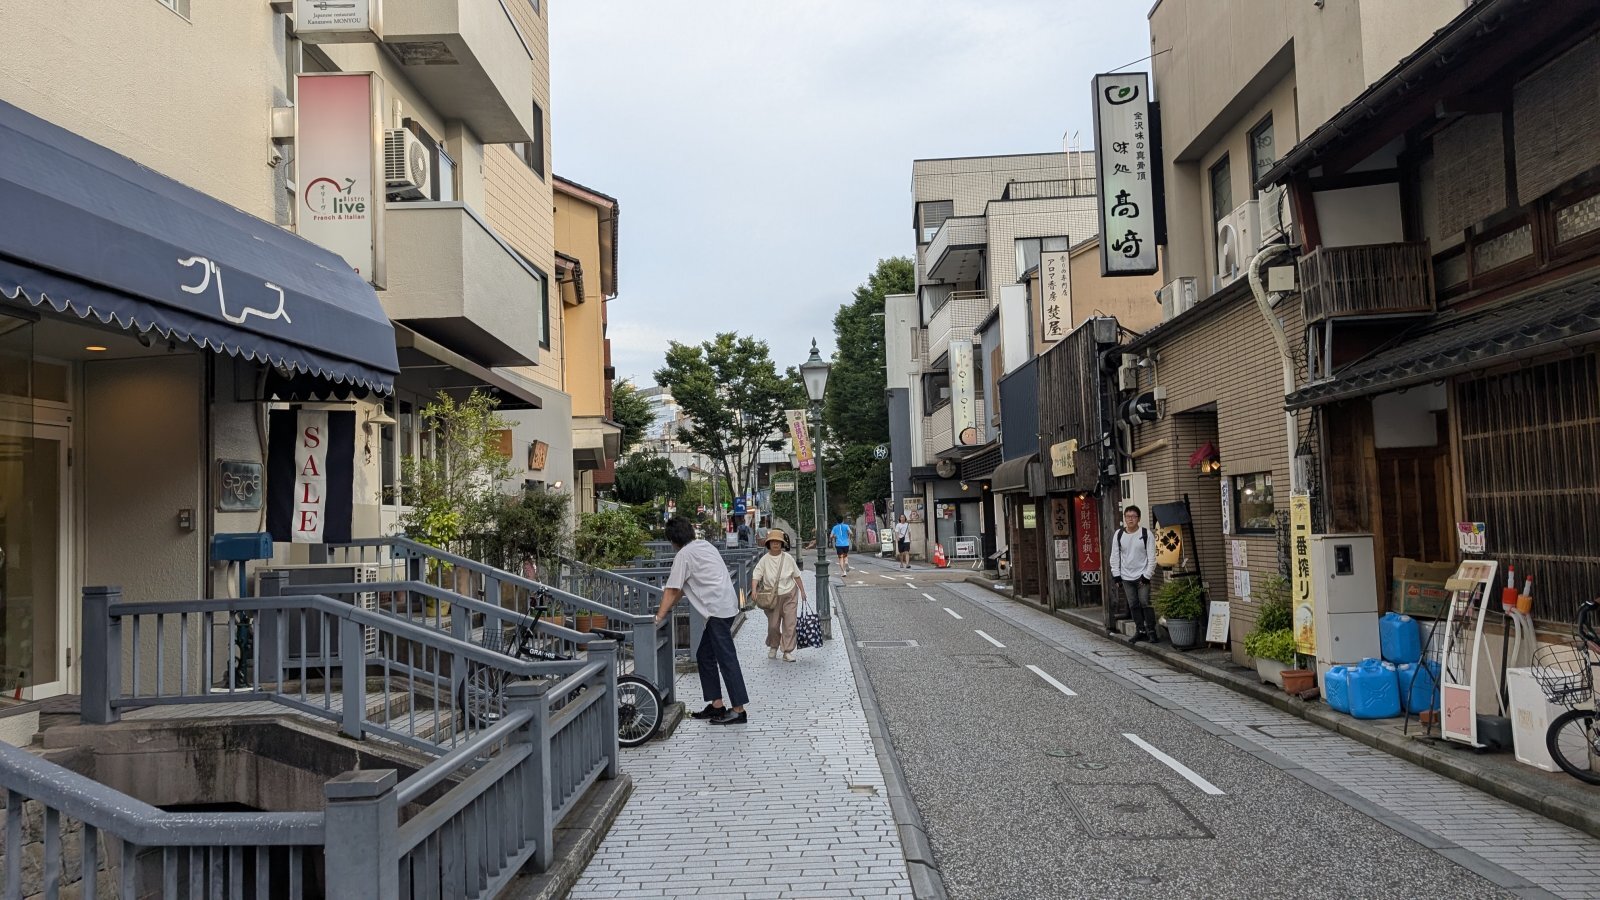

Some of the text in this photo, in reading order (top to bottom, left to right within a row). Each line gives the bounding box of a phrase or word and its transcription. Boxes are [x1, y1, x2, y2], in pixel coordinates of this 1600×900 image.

[1134, 111, 1147, 181] 金沢味の真骨頂
[298, 426, 321, 532] SALE
[1081, 572, 1100, 583] 300
[1295, 524, 1310, 600] 一番搾り
